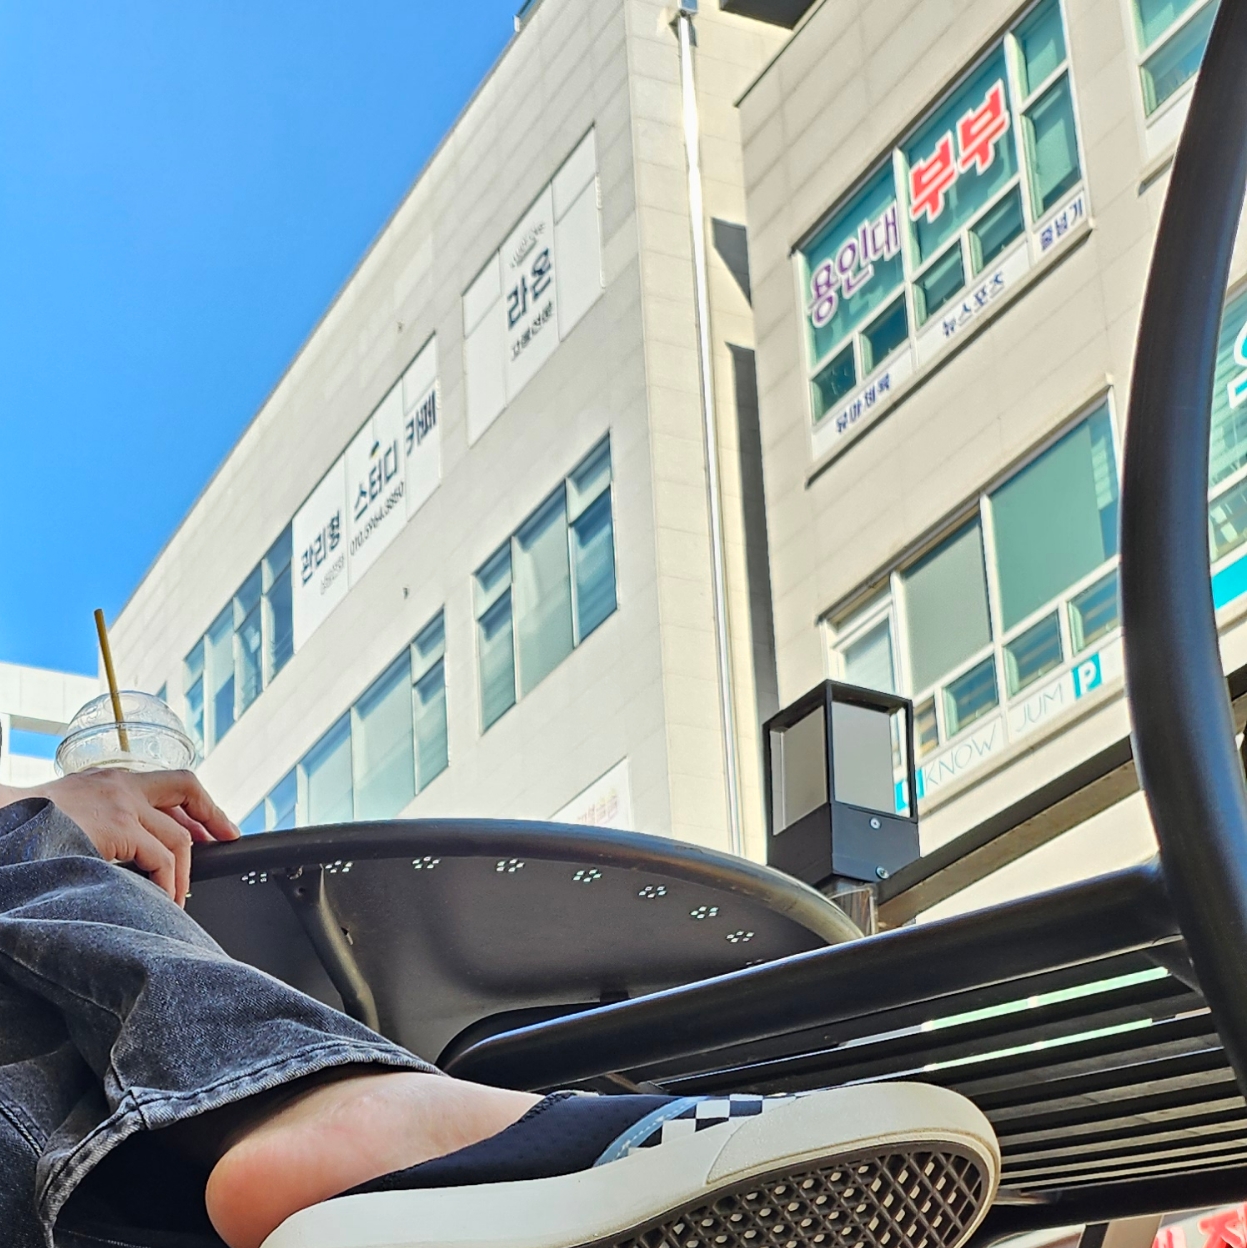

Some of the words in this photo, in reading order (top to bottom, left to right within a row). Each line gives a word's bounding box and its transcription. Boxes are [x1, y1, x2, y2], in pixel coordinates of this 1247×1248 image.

[807, 200, 900, 328] 용인대
[910, 79, 1009, 222] 부부
[507, 247, 552, 331] 라온
[835, 372, 890, 433] 유아체육
[301, 509, 341, 586] 관리형
[354, 439, 398, 522] 스터디
[406, 391, 437, 457] 카페
[924, 725, 996, 789] KNOW
